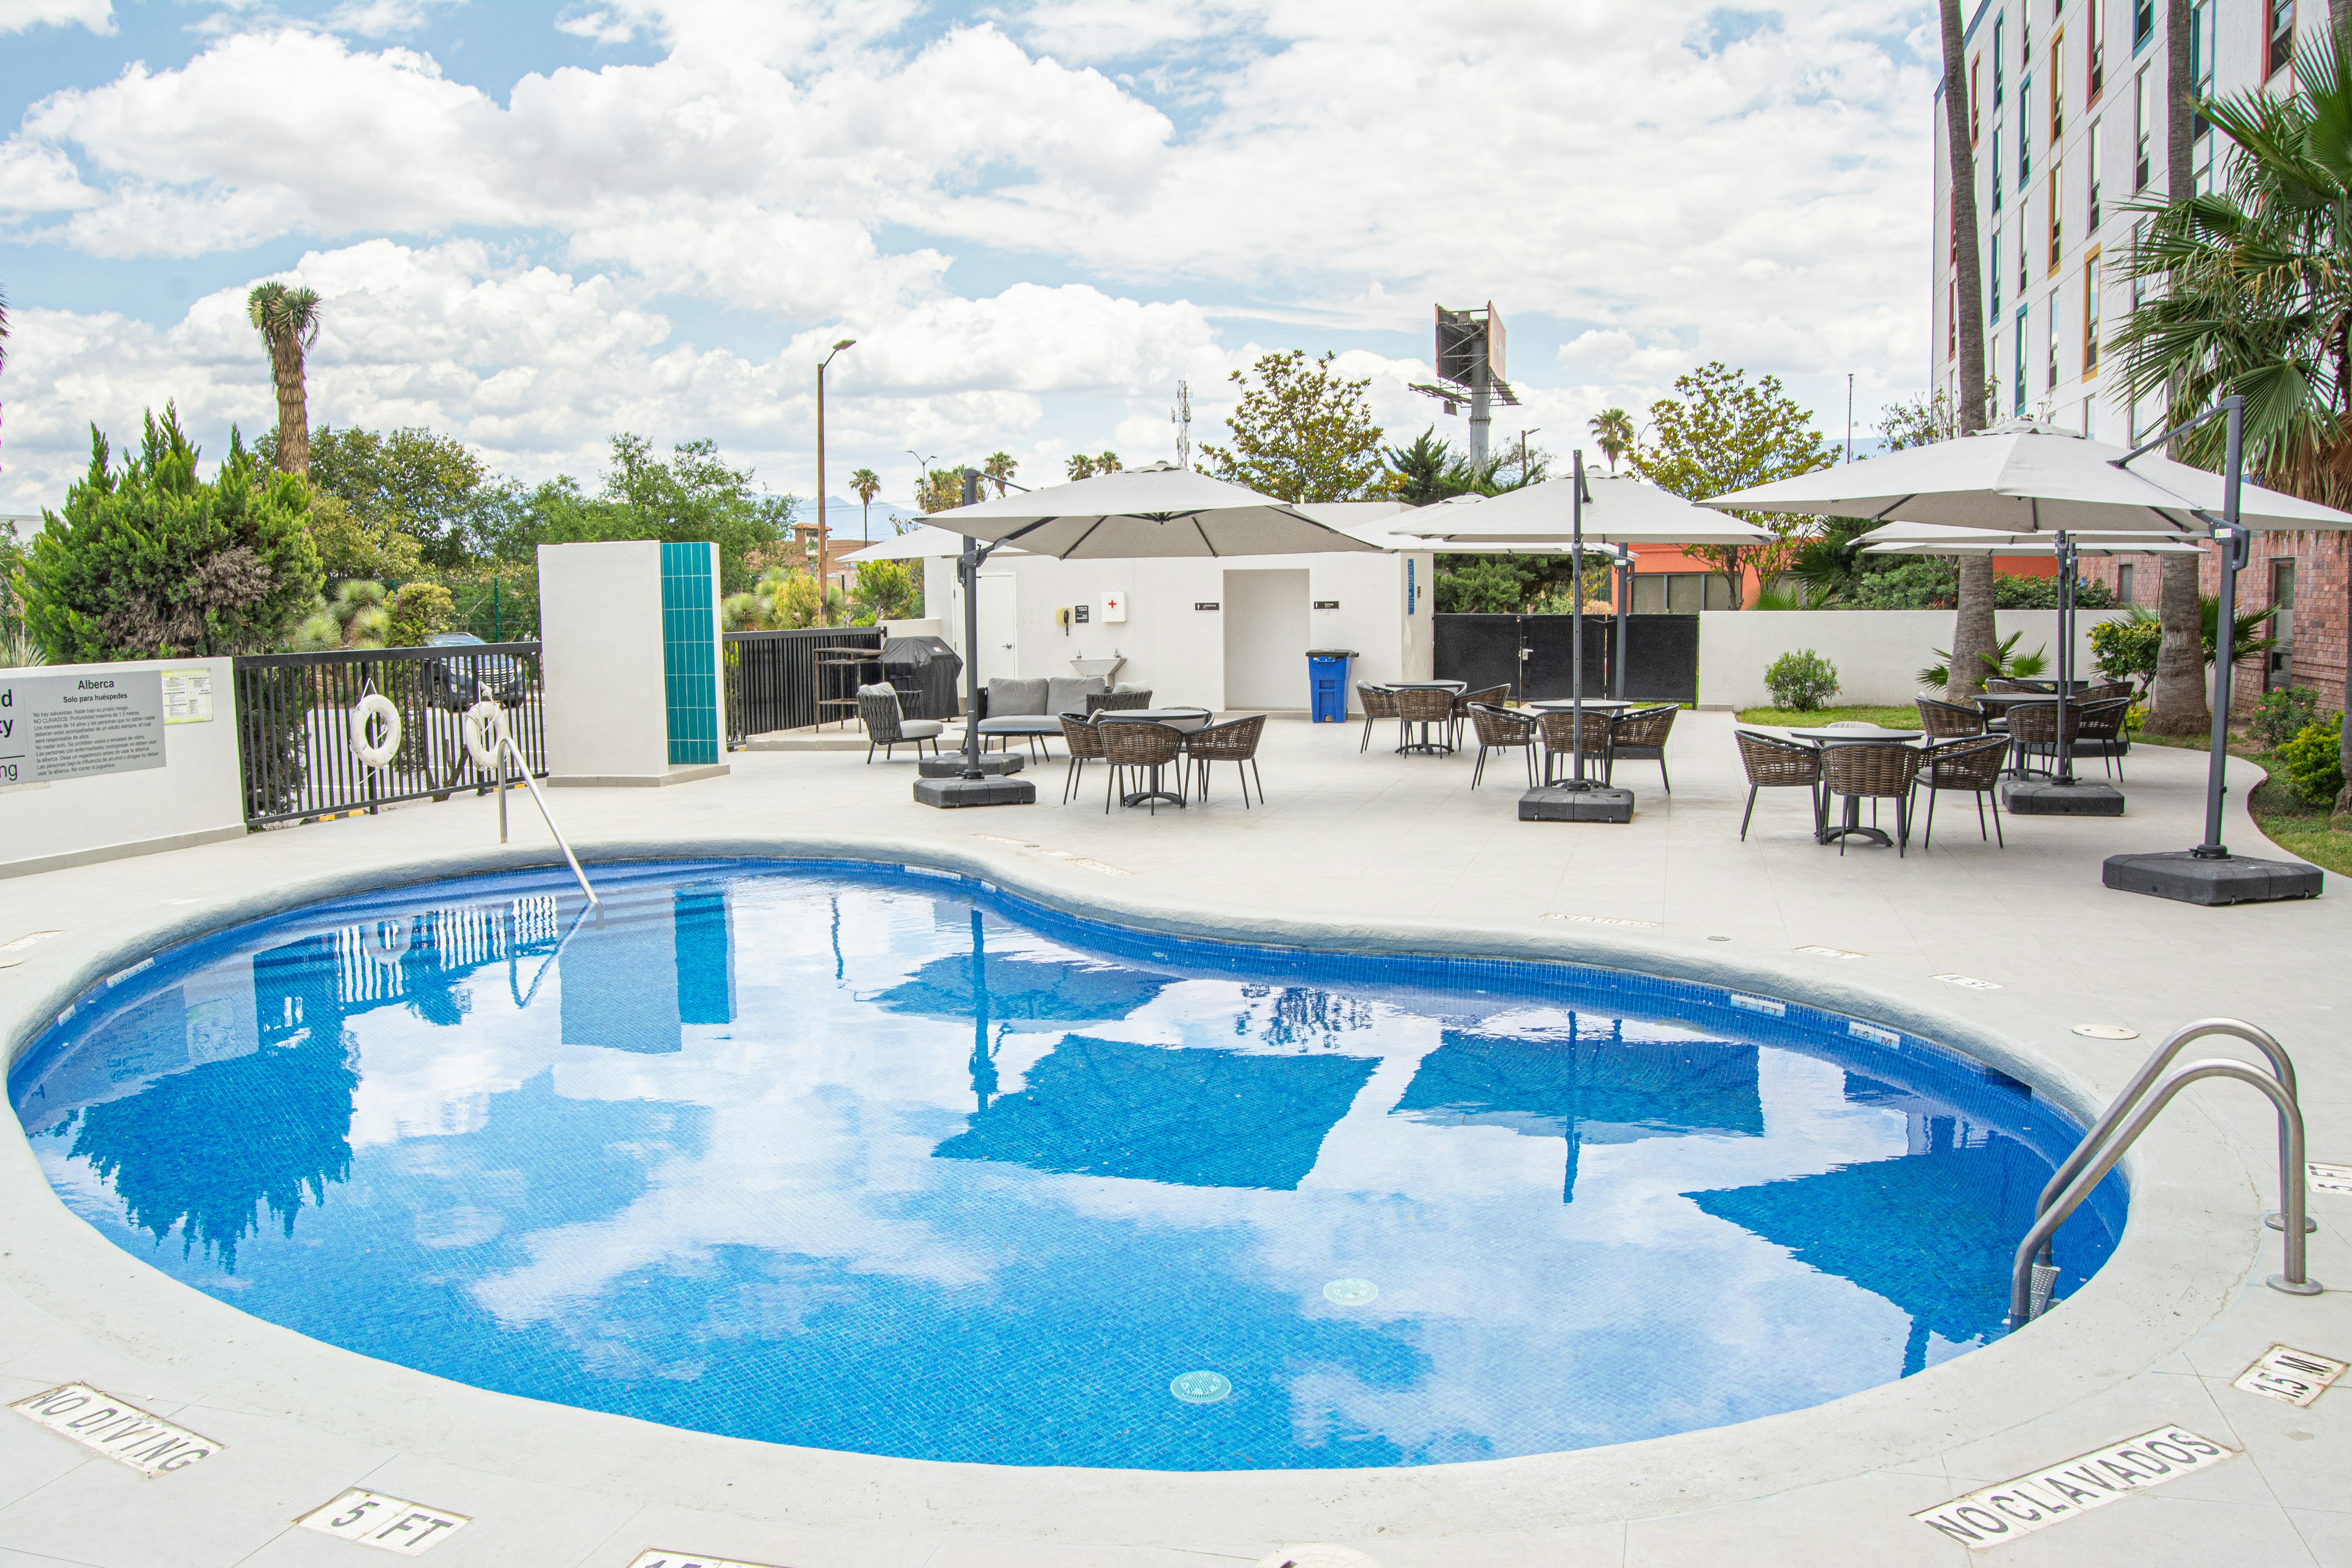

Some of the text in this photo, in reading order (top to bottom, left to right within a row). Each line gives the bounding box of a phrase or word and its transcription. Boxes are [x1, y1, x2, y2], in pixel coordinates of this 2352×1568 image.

[78, 680, 114, 690] Alberca
[95, 693, 127, 701] huéspedes
[1544, 914, 1621, 924] DIVING
[1761, 1005, 1780, 1015] FT
[1852, 1028, 1893, 1047] 1.5 M
[2308, 1165, 2351, 1180] FT
[2249, 1354, 2333, 1398] 1.5 M
[22, 1388, 209, 1472] NO DIVING
[331, 1501, 455, 1547] 5 FT
